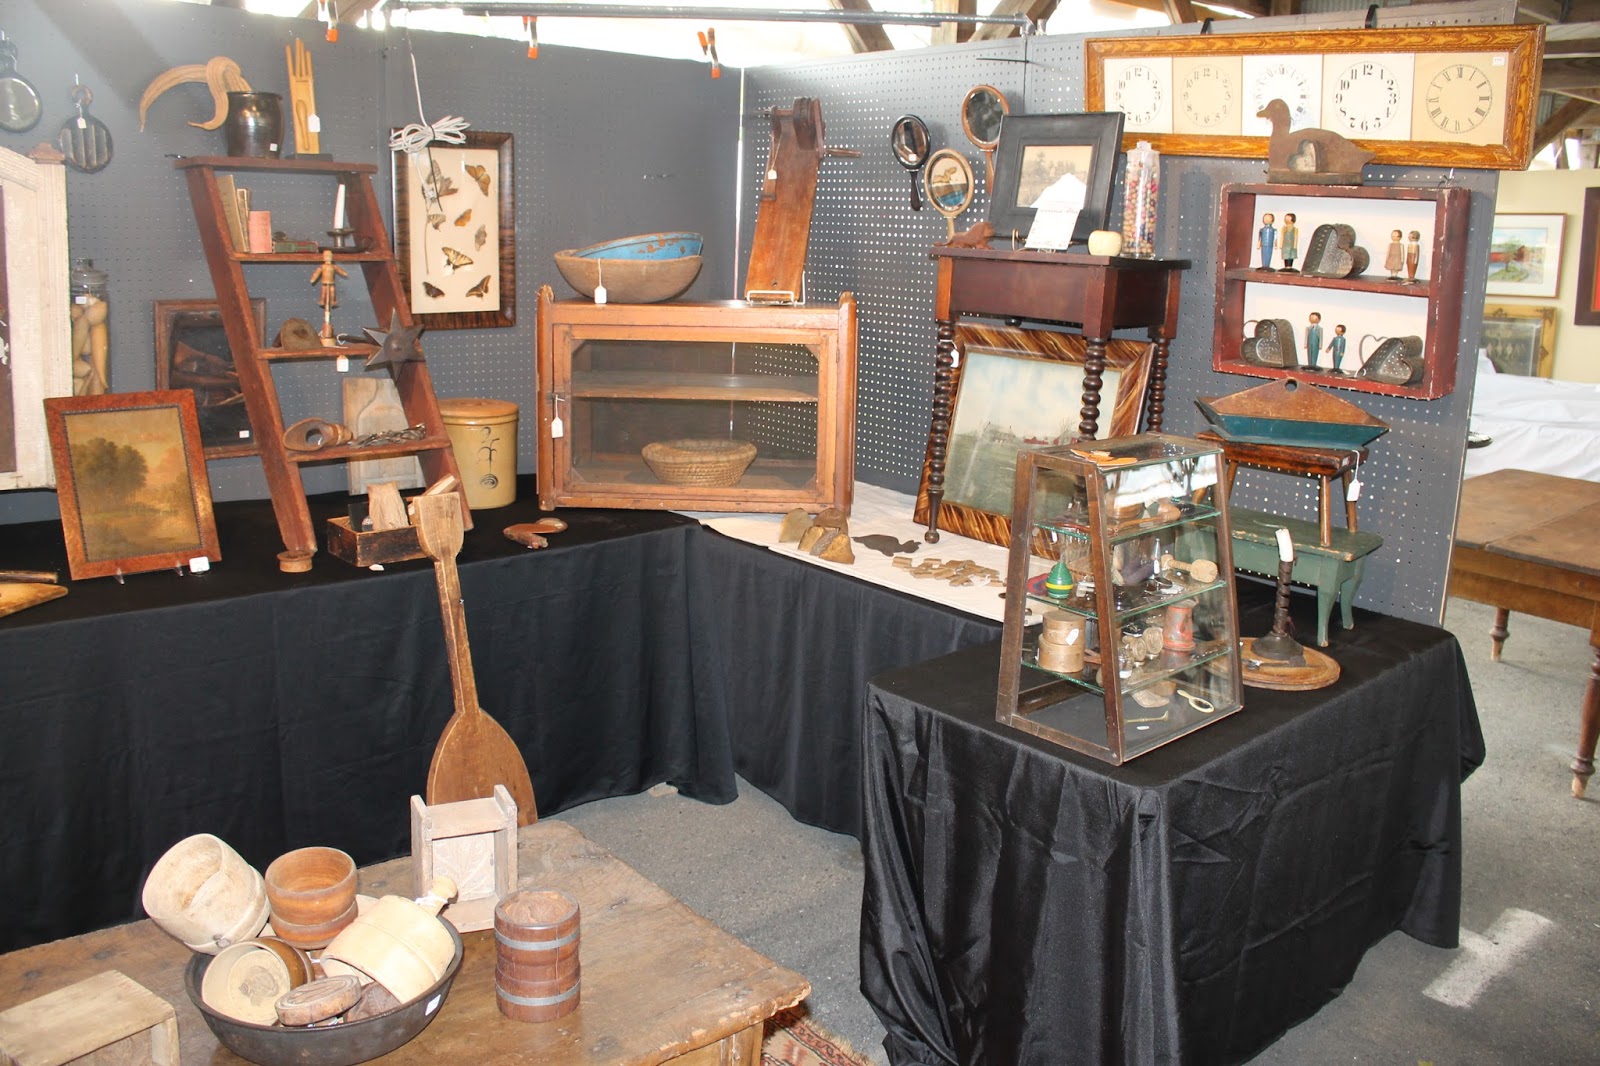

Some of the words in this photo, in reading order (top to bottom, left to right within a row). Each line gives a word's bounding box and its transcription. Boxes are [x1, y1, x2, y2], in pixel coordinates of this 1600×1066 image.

[1350, 68, 1357, 80] 11
[1363, 64, 1373, 76] 12
[1380, 68, 1384, 80] 1
[1340, 79, 1350, 91] 10
[1386, 79, 1394, 91] 2
[1335, 92, 1343, 105] 9
[1388, 92, 1397, 105] 3
[1339, 106, 1347, 118] 8
[1360, 120, 1368, 132] 6
[1373, 117, 1381, 129] 5
